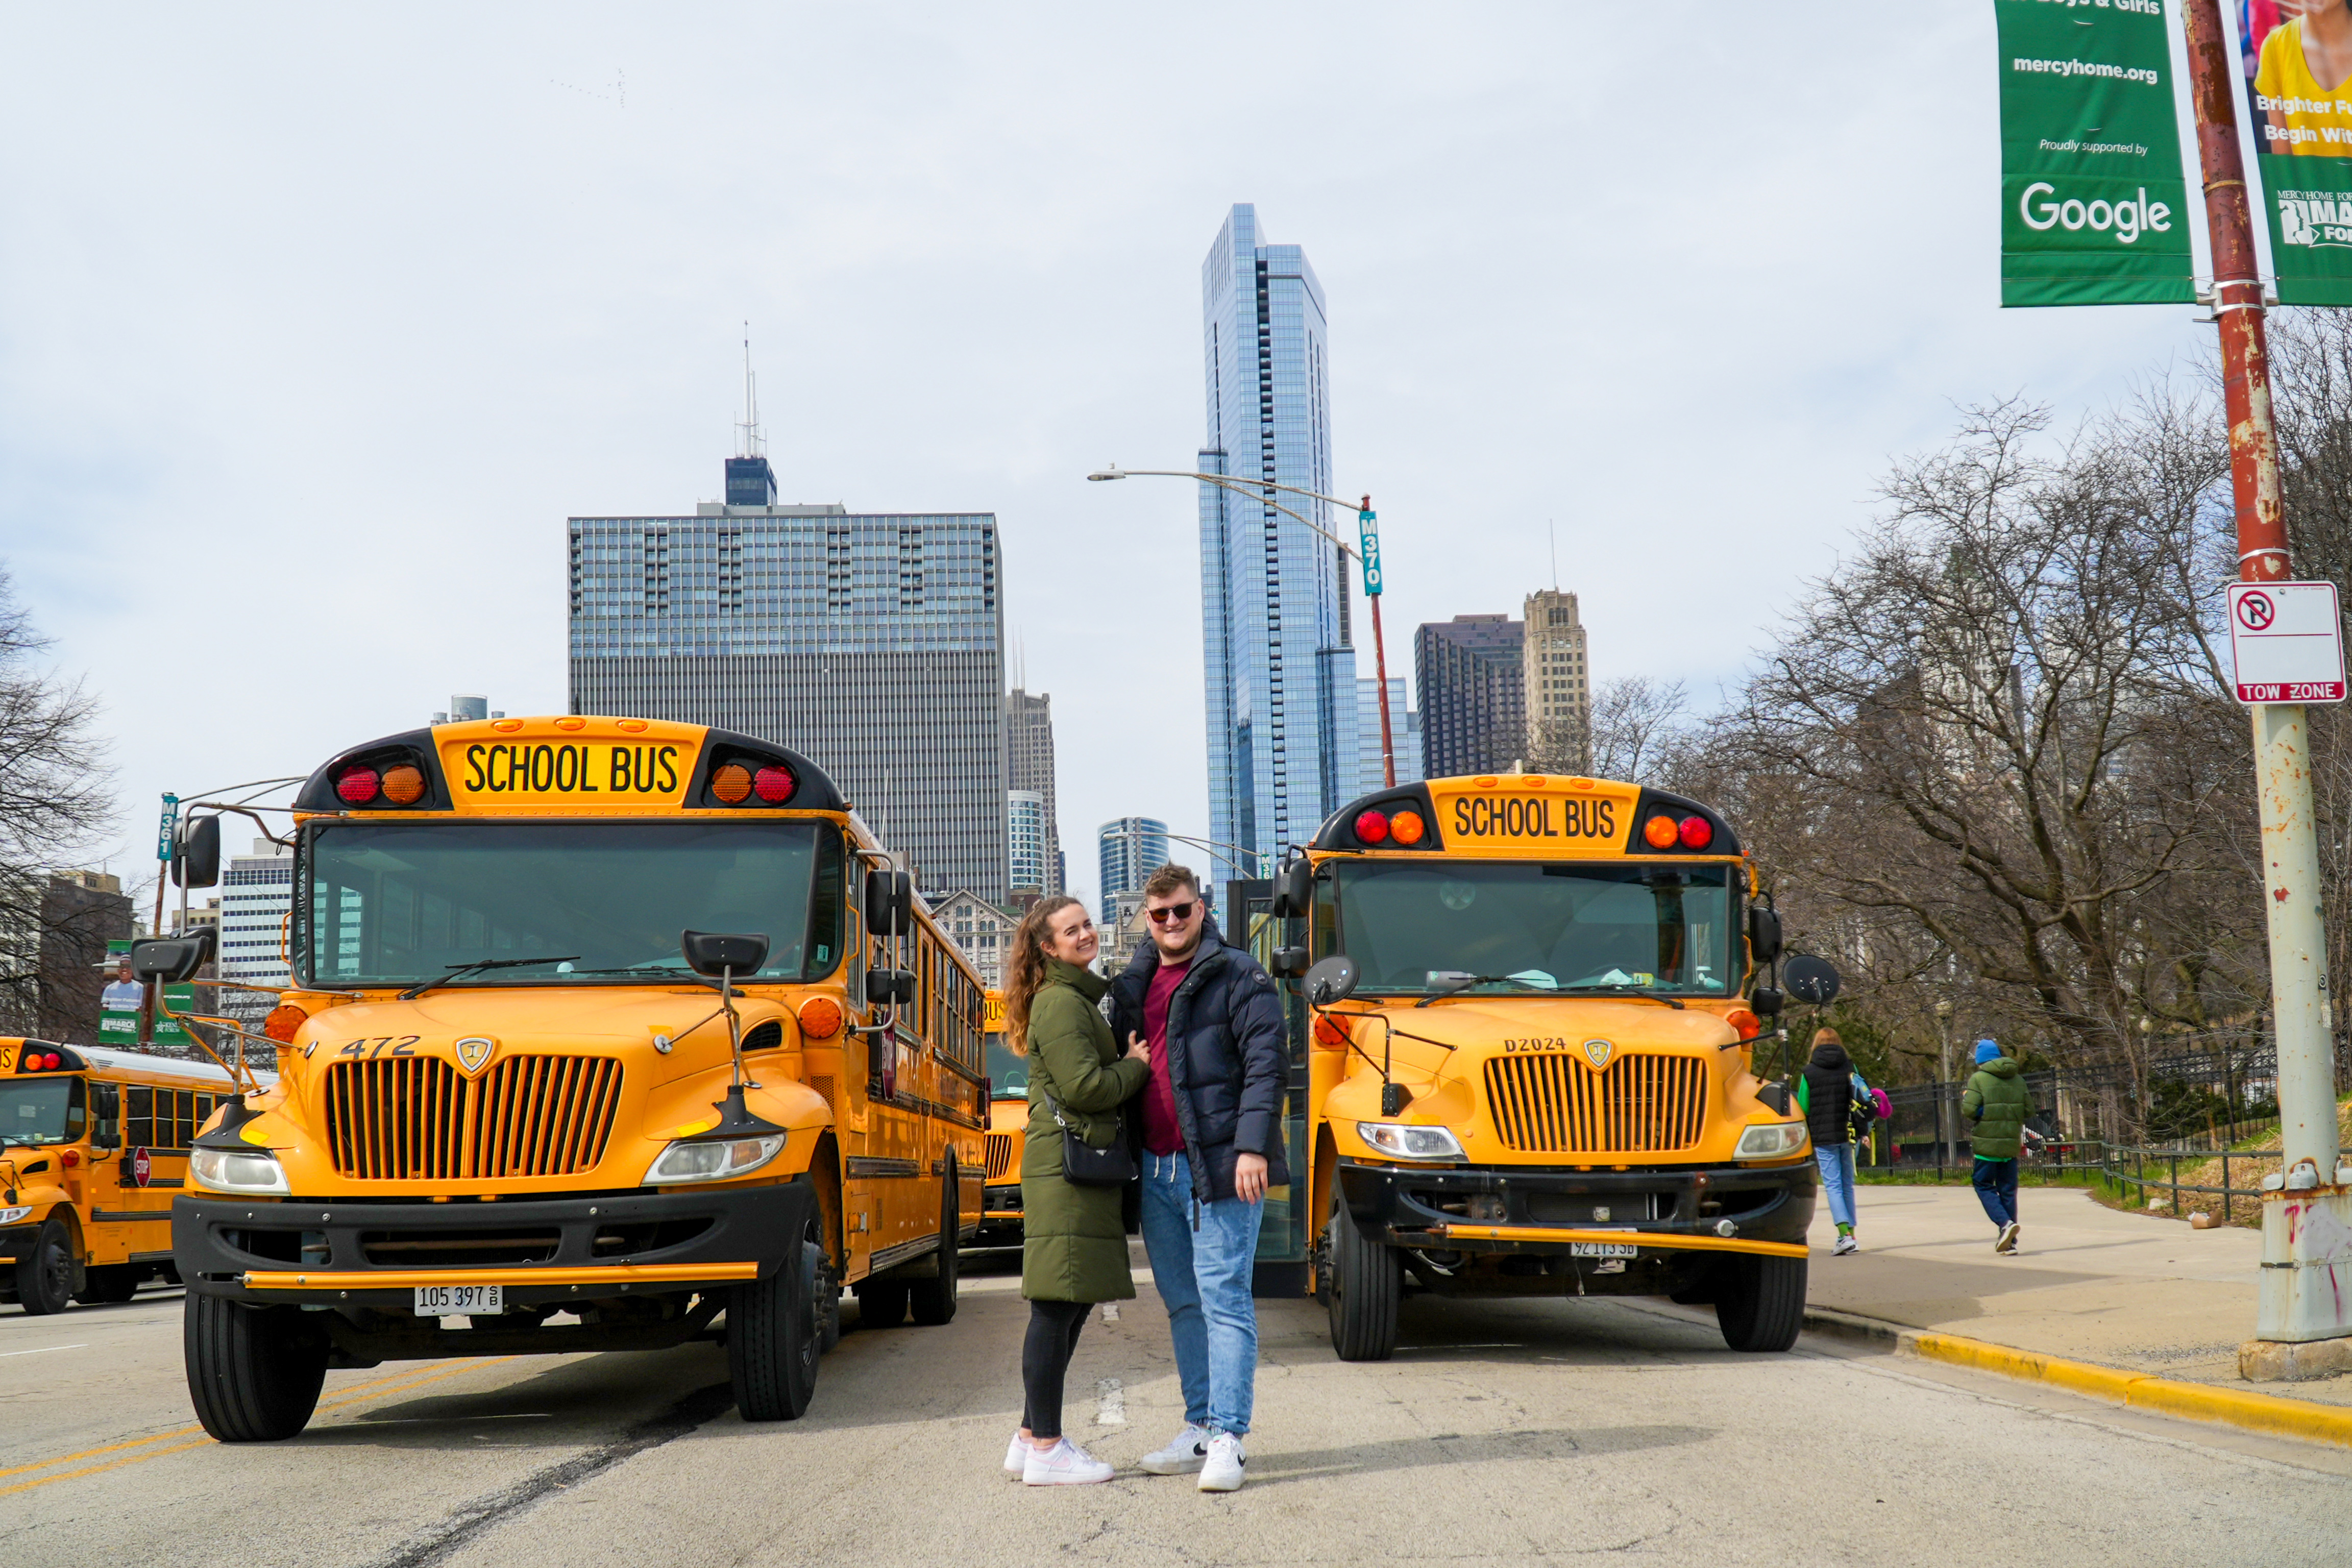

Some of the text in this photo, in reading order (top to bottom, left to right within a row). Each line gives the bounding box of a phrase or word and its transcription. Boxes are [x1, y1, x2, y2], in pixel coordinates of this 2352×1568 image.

[2115, 0, 2160, 15] Girls
[2014, 58, 2158, 85] mercyhome.org
[2257, 95, 2332, 115] Brighter
[2265, 125, 2317, 144] Begin
[2040, 139, 2148, 156] Proudly supported by
[2277, 190, 2305, 199] MERCY
[2306, 191, 2334, 201] HOME
[2021, 182, 2172, 243] Google
[1362, 519, 1380, 584] M370
[2243, 683, 2336, 699] TOW ZONE
[465, 744, 678, 793] SCHOOL BUS
[161, 802, 176, 853] M361
[1455, 797, 1615, 838] SCHOOL BUS
[341, 1036, 421, 1060] 472
[1504, 1038, 1566, 1052] D2024
[136, 1160, 149, 1174] STOP
[420, 1287, 449, 1307] 105
[455, 1286, 484, 1306] 397
